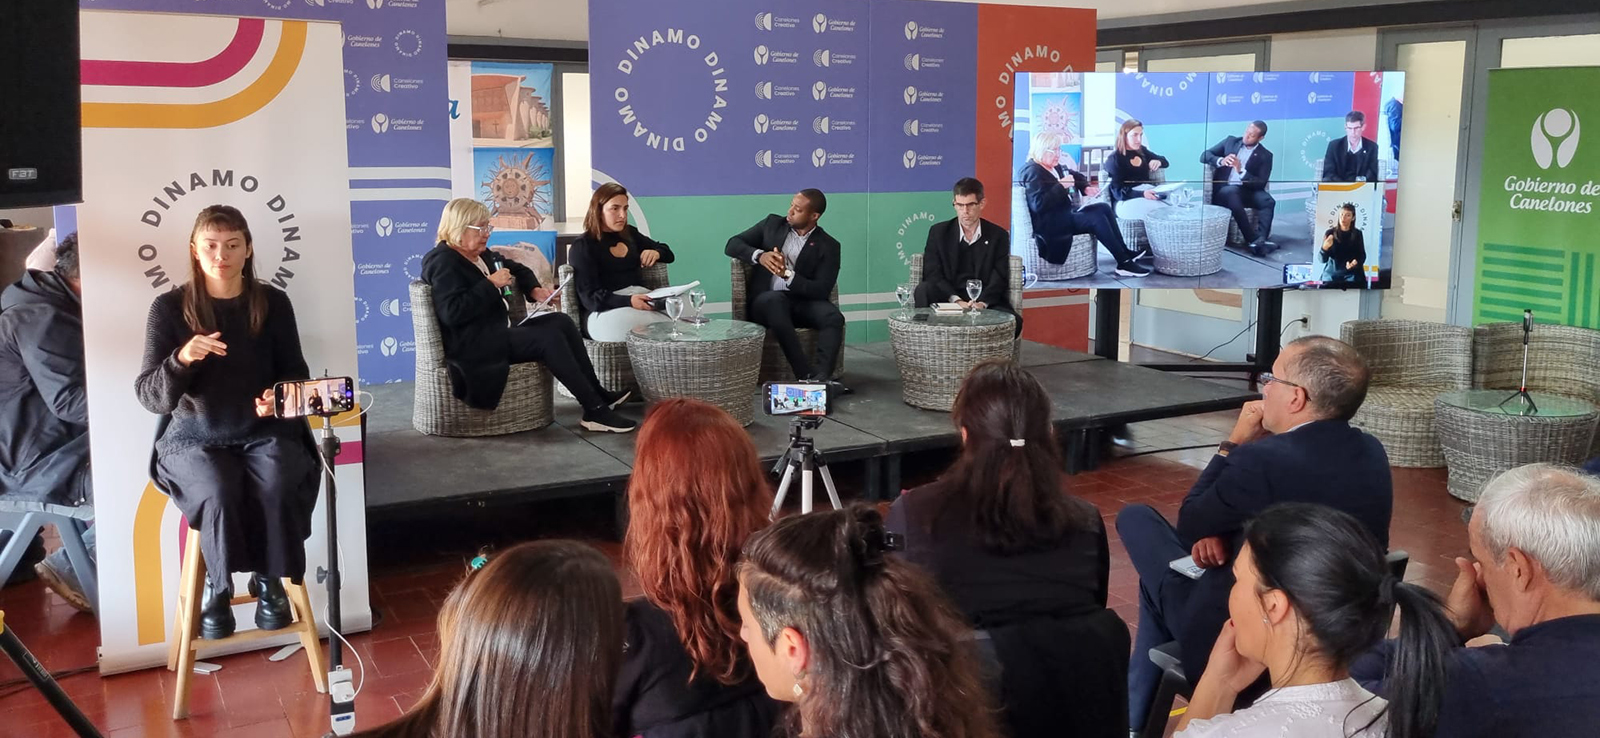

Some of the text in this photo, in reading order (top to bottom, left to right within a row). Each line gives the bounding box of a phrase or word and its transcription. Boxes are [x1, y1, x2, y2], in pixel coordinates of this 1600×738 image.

[618, 28, 700, 74] DINAMO
[999, 45, 1060, 84] DINAMO
[614, 87, 685, 151] DINAMO
[694, 52, 728, 142] DINAMO
[141, 169, 258, 228] DINAMO
[1504, 176, 1600, 196] Gobierno de
[1510, 193, 1592, 213] Canelones
[266, 194, 301, 289] DINAM
[898, 212, 935, 236] DINAMO
